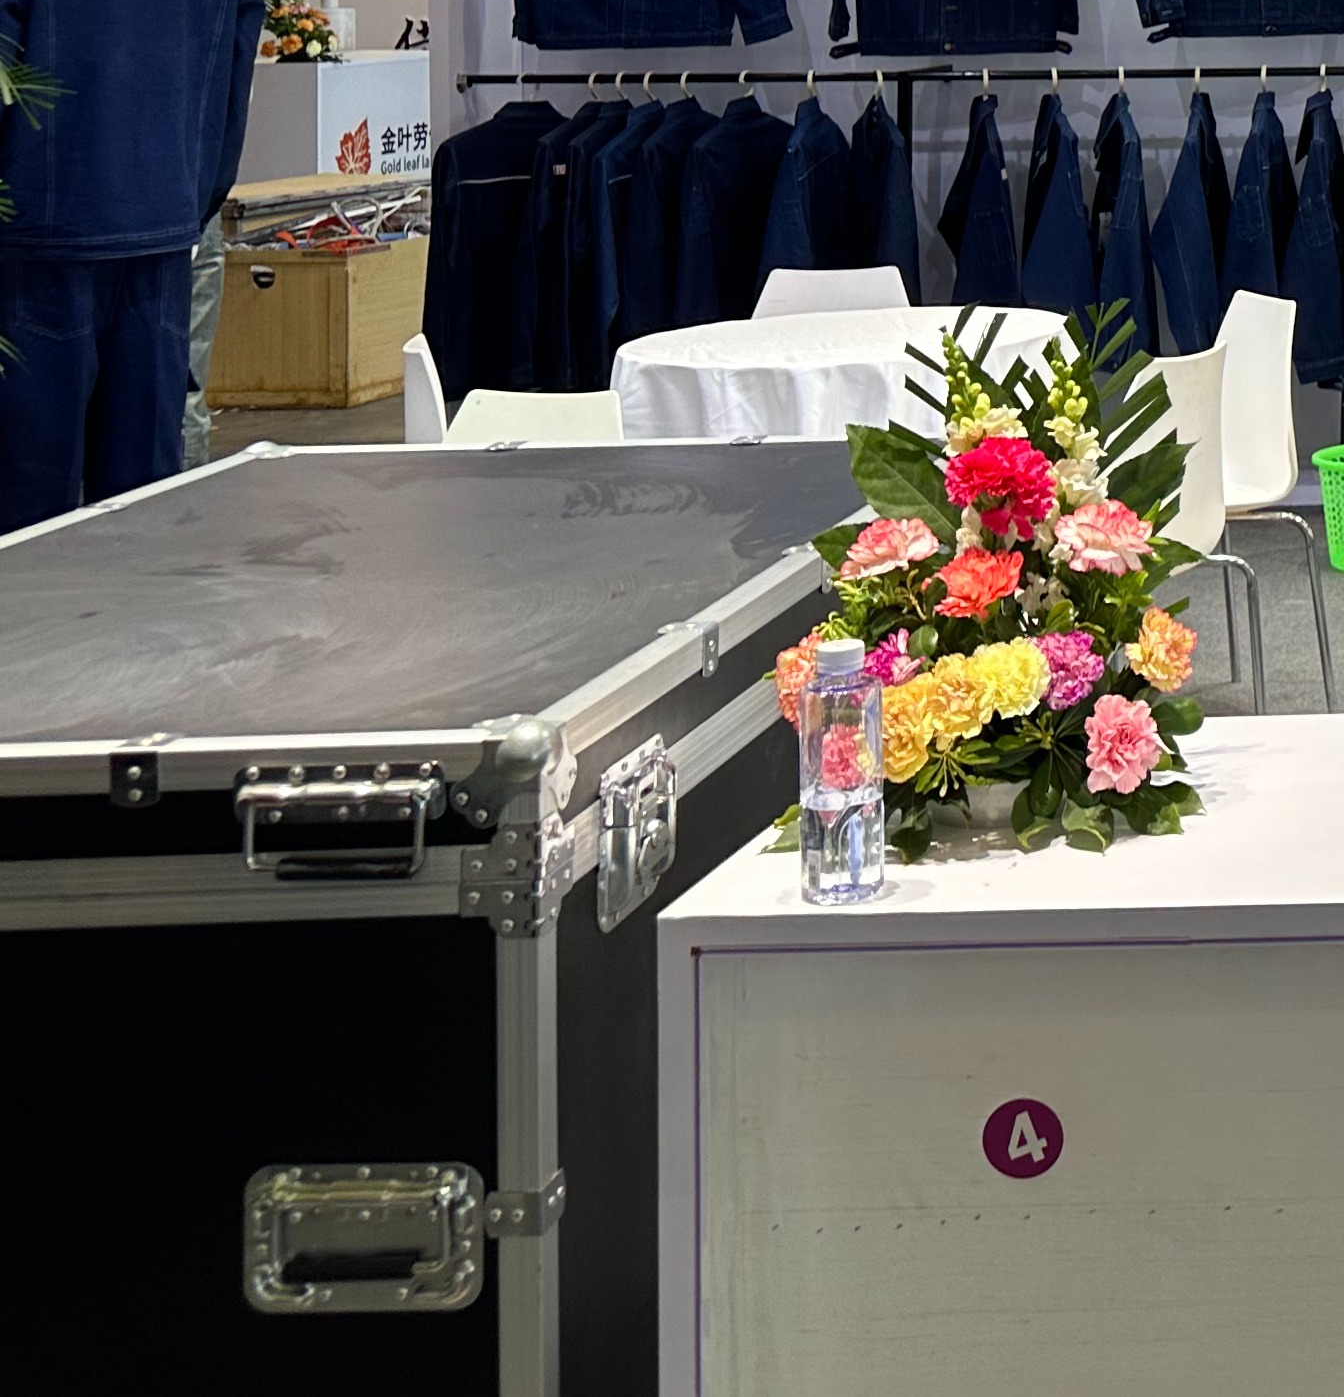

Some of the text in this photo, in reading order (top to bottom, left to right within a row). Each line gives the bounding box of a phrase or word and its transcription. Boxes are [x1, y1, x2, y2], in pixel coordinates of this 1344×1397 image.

[381, 158, 401, 175] Gold
[404, 154, 420, 171] leaf
[1008, 1110, 1048, 1164] 4
